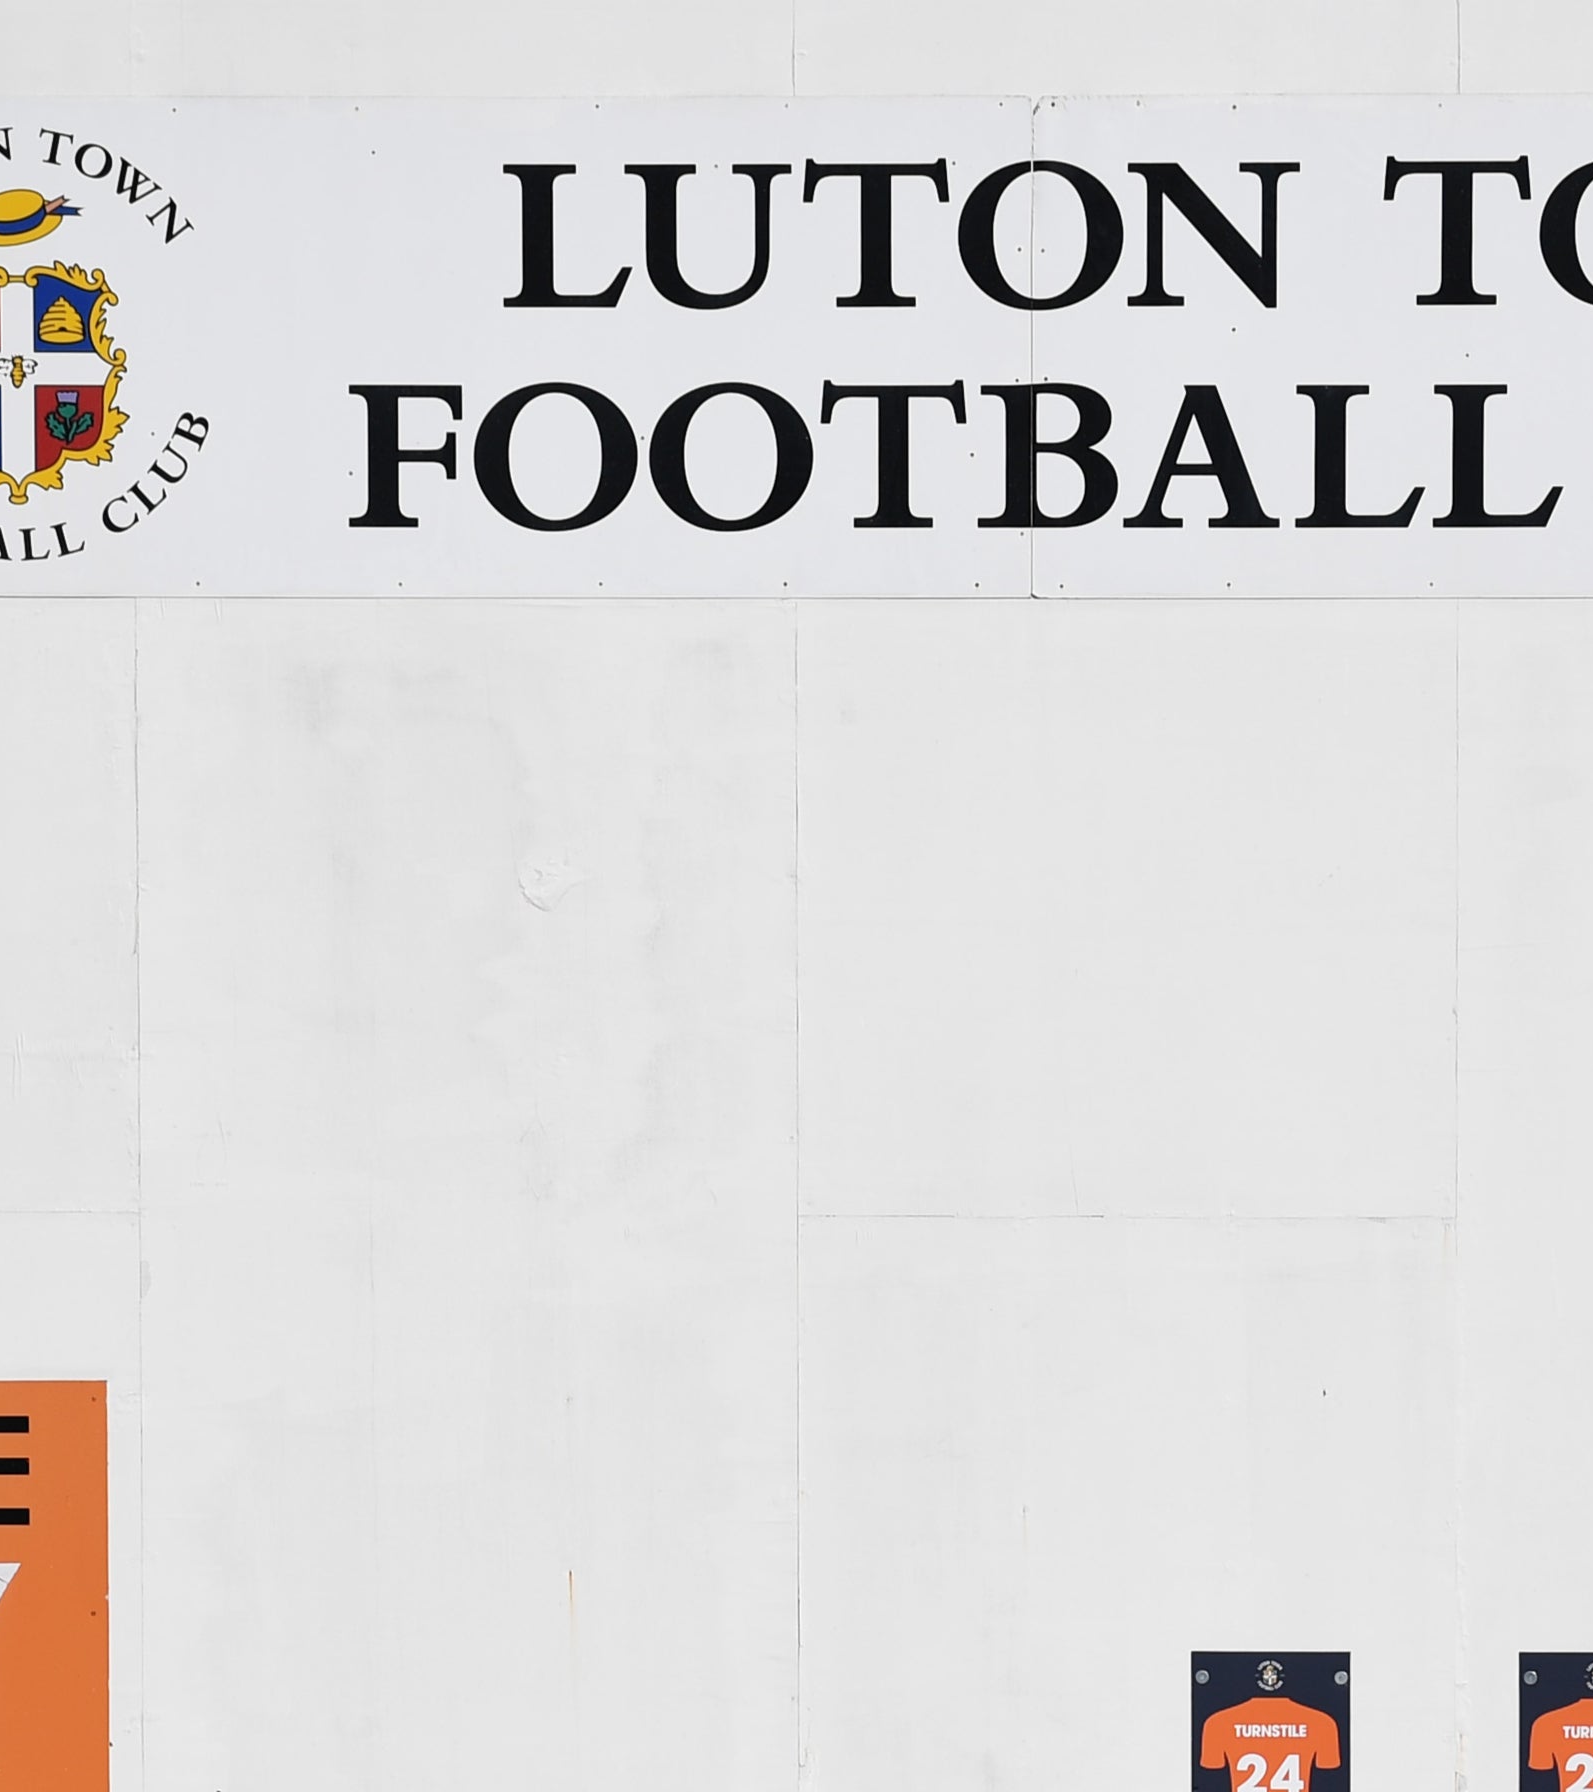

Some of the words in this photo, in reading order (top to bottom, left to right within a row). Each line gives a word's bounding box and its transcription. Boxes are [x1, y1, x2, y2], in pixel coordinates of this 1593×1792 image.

[39, 128, 194, 244] TOWN
[503, 158, 1300, 310] LUTON
[102, 412, 210, 532] CLUB
[349, 380, 1563, 531] FOOTBALL
[1234, 1725, 1306, 1737] TURNSTILE
